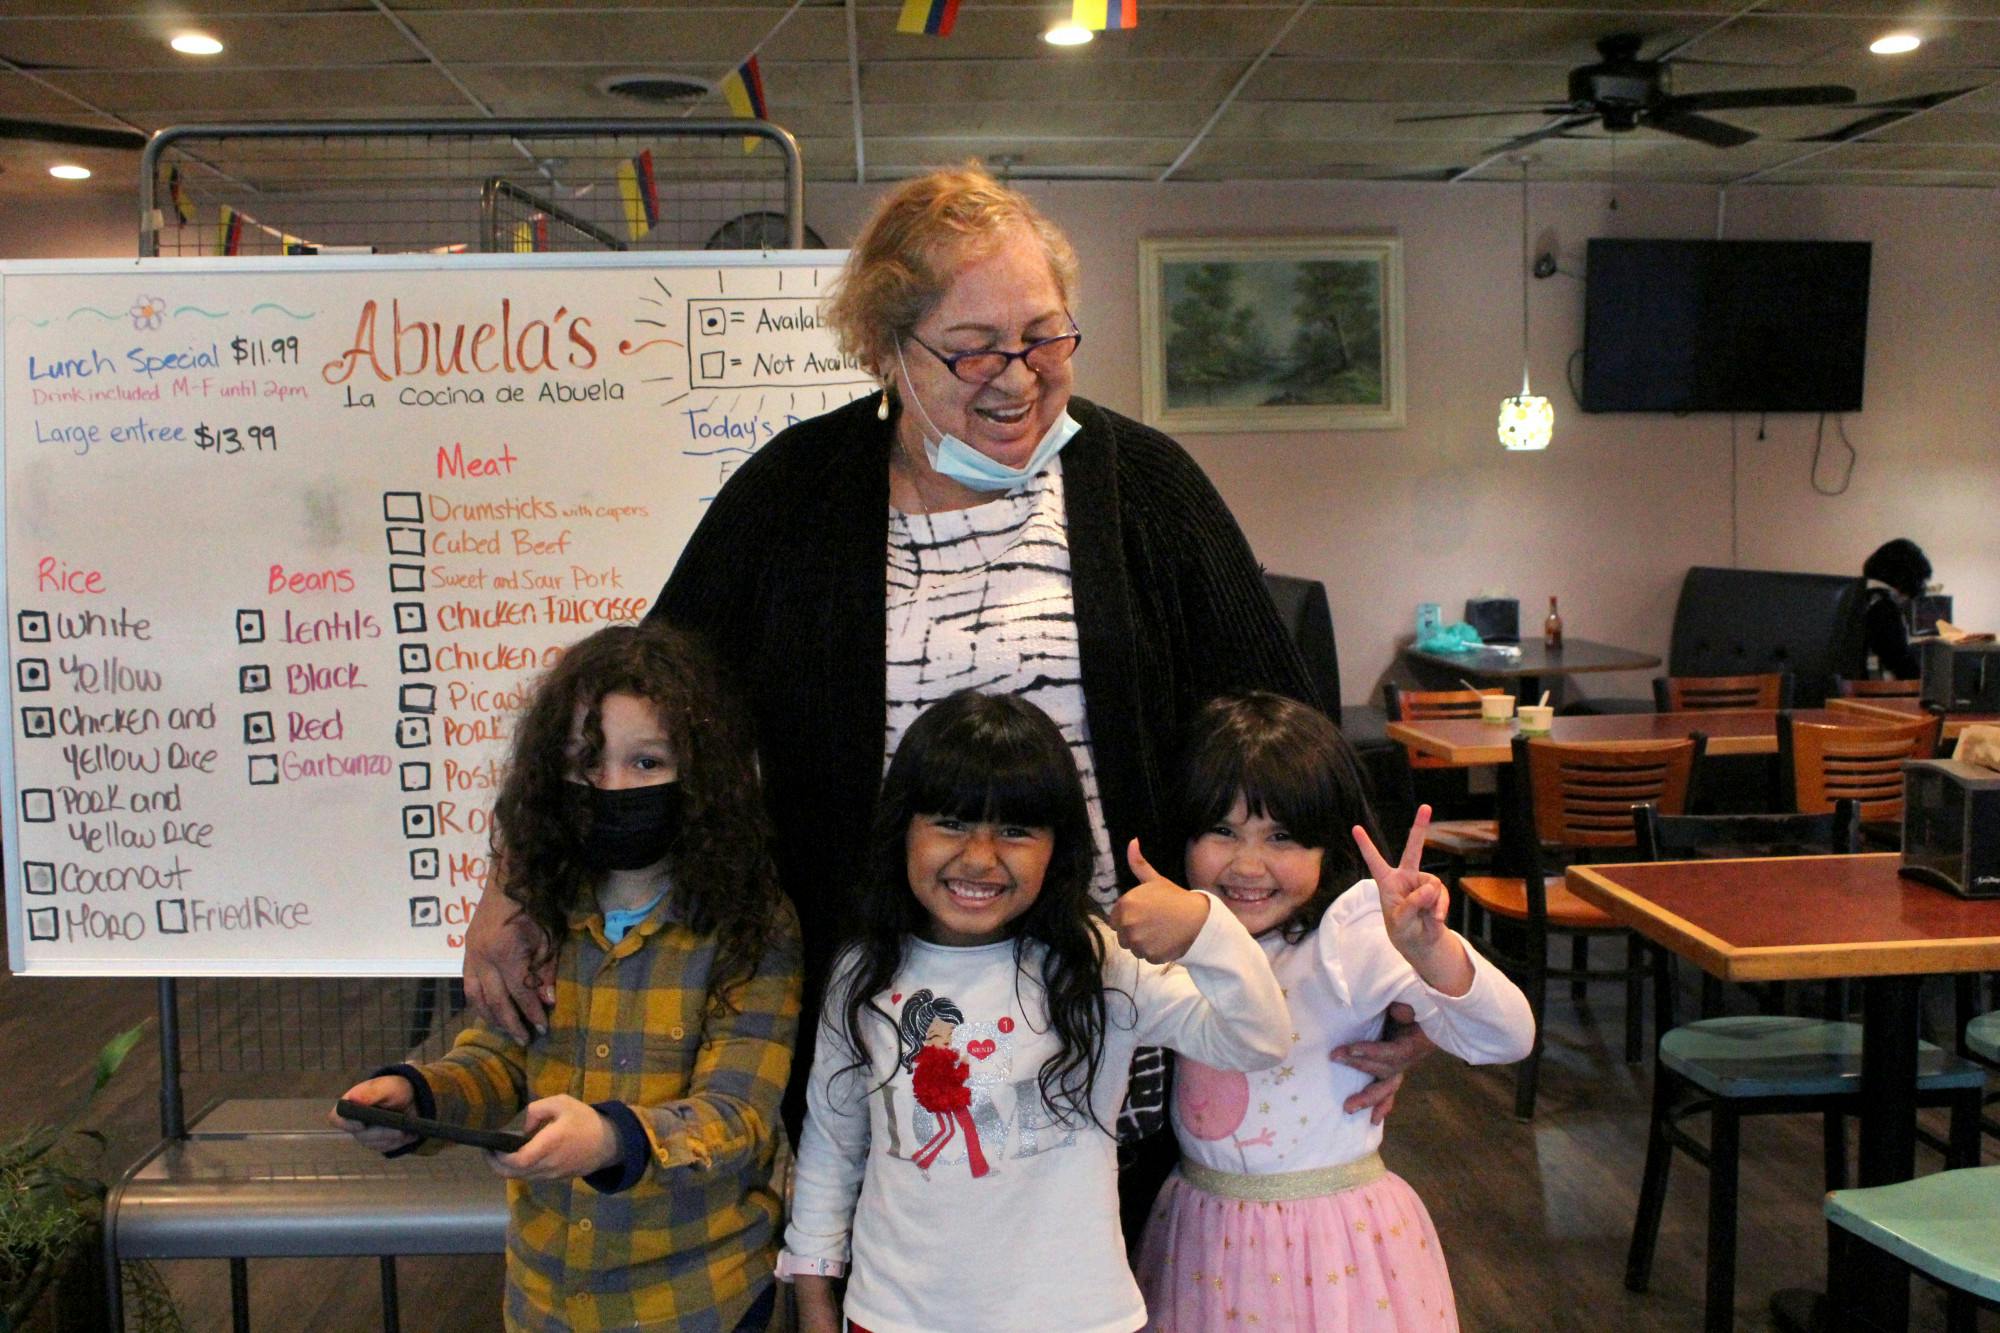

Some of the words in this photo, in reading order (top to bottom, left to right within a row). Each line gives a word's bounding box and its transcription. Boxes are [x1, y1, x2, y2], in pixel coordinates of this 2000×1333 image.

[755, 306, 826, 334] Availab
[322, 297, 598, 384] Abuela's
[29, 350, 116, 381] Lunch
[126, 343, 220, 380] Special
[231, 336, 300, 366] $11.99
[753, 352, 796, 377] Not
[804, 351, 859, 375] Availa
[32, 387, 83, 406] Drink
[87, 381, 161, 403] included
[220, 379, 257, 398] until
[263, 380, 310, 402] 2pm
[343, 385, 376, 408] La
[399, 383, 484, 407] Cocina
[497, 382, 526, 404] de
[539, 378, 625, 404] Abuela
[35, 419, 101, 456] Large
[110, 417, 187, 443] entree
[194, 425, 278, 454] $13.99
[680, 408, 774, 450] Today's
[437, 442, 518, 480] Meat
[428, 494, 557, 524] Drumsticks
[561, 505, 593, 519] with
[596, 505, 649, 522] capers
[432, 529, 500, 556] Cubed
[511, 528, 573, 557] Beef
[38, 555, 107, 594] Rice
[268, 564, 355, 594] Beans
[431, 565, 486, 591] Sweet
[493, 567, 519, 590] and
[524, 566, 562, 590] Sour
[570, 564, 625, 591] PORK
[286, 662, 368, 695] Black
[448, 681, 523, 713] Picad
[168, 702, 217, 731] and
[287, 708, 344, 742] Red
[130, 783, 182, 814] and
[191, 898, 252, 933] Fried
[253, 896, 313, 931] Rice
